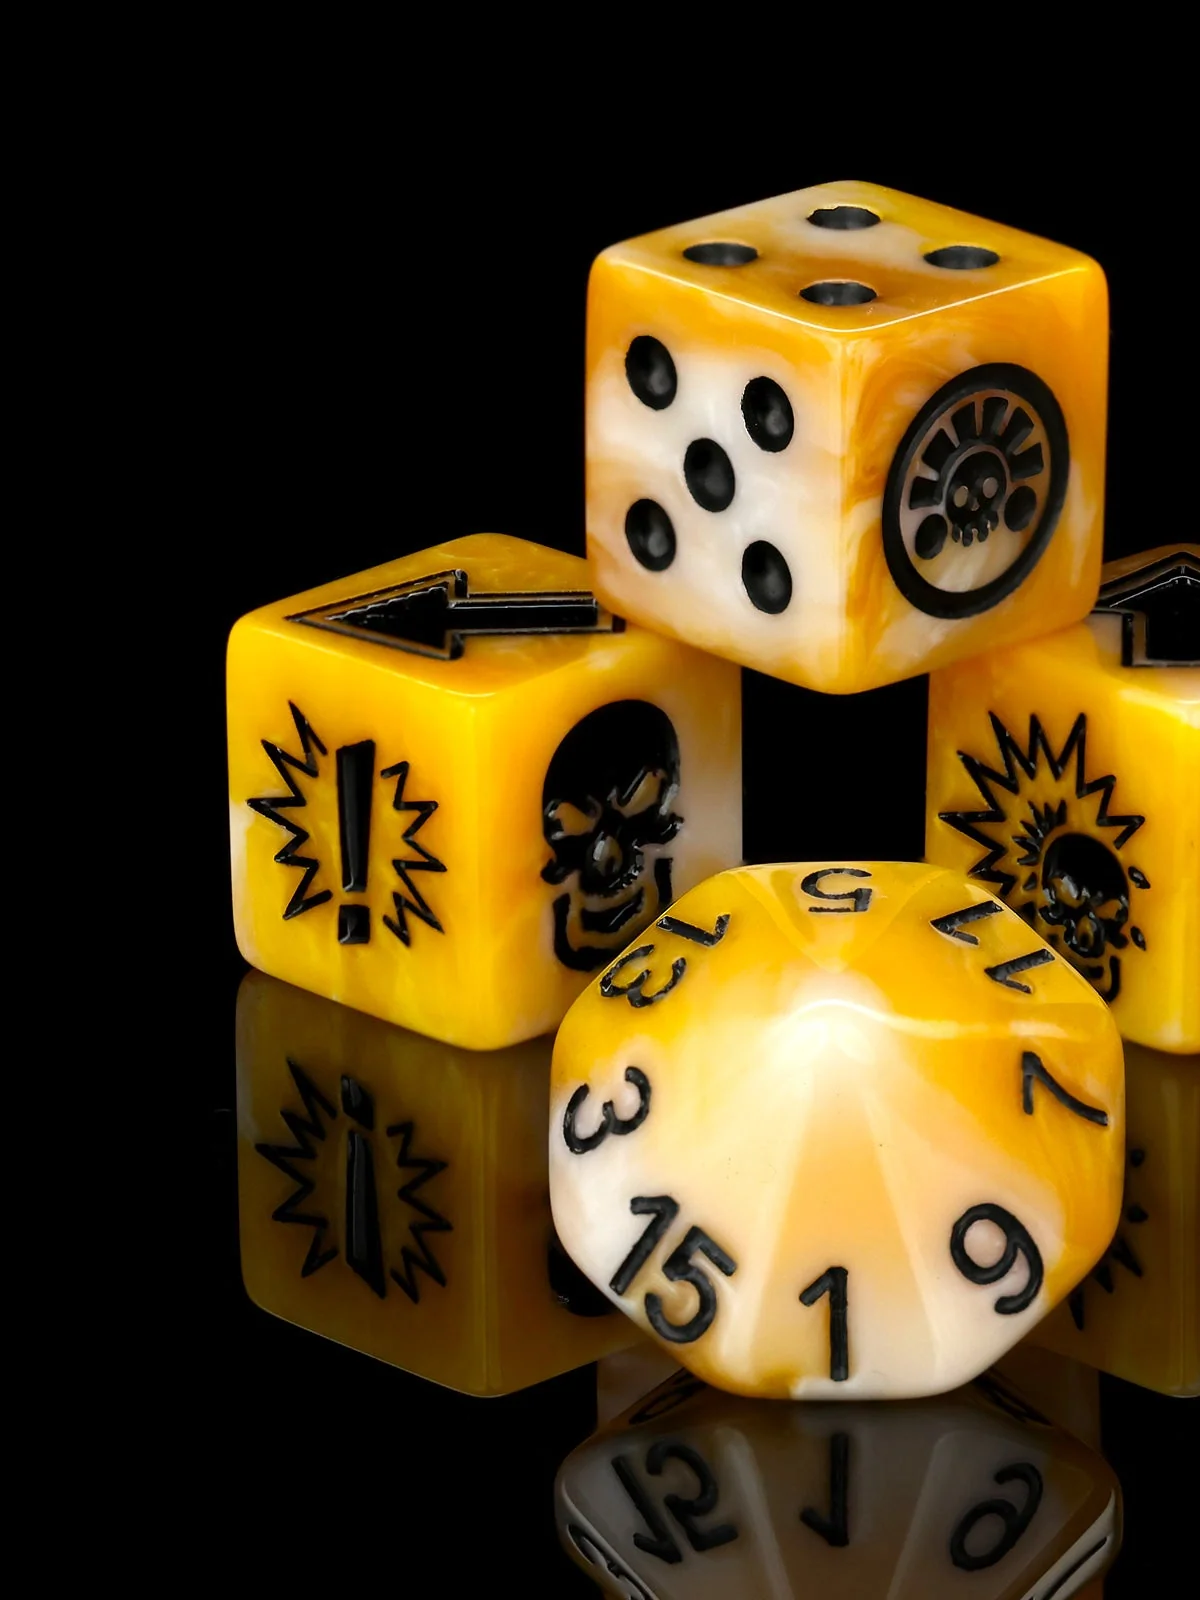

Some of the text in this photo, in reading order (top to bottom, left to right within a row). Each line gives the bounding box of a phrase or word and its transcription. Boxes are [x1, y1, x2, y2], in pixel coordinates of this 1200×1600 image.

[562, 1066, 651, 1154] 3
[609, 1195, 737, 1344] 15
[950, 1203, 1044, 1315] 9
[799, 1266, 849, 1382] 1
